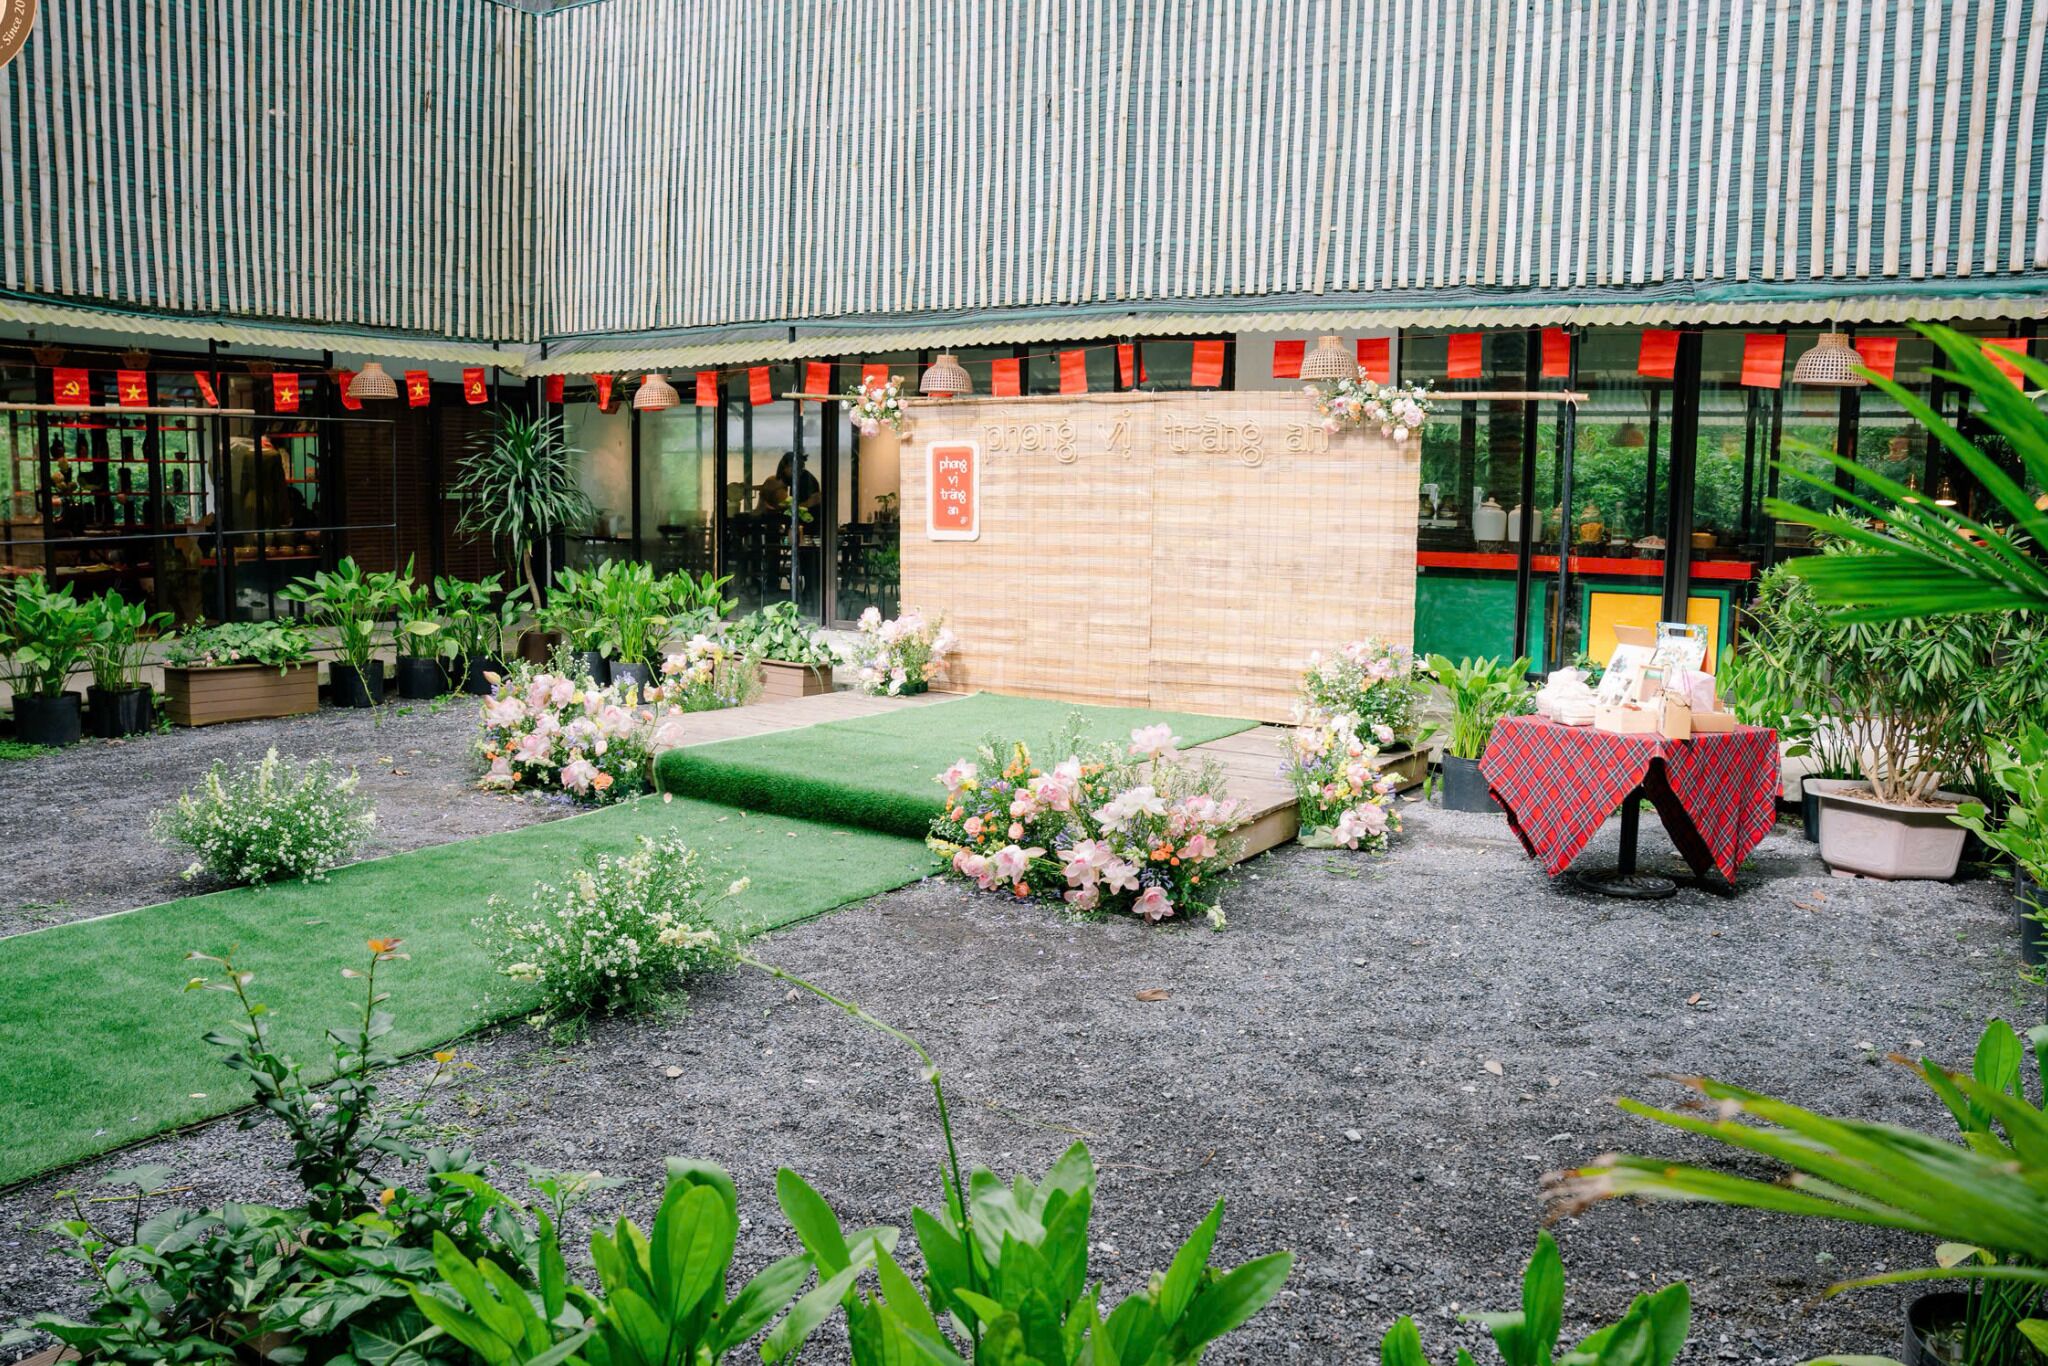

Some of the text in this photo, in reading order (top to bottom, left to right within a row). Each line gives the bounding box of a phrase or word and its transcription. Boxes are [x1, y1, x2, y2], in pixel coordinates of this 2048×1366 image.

[983, 410, 1078, 465] phong
[1098, 409, 1131, 460] vị
[1285, 423, 1329, 453] an
[939, 456, 968, 474] phong
[947, 471, 959, 487] vị
[947, 505, 959, 516] an
